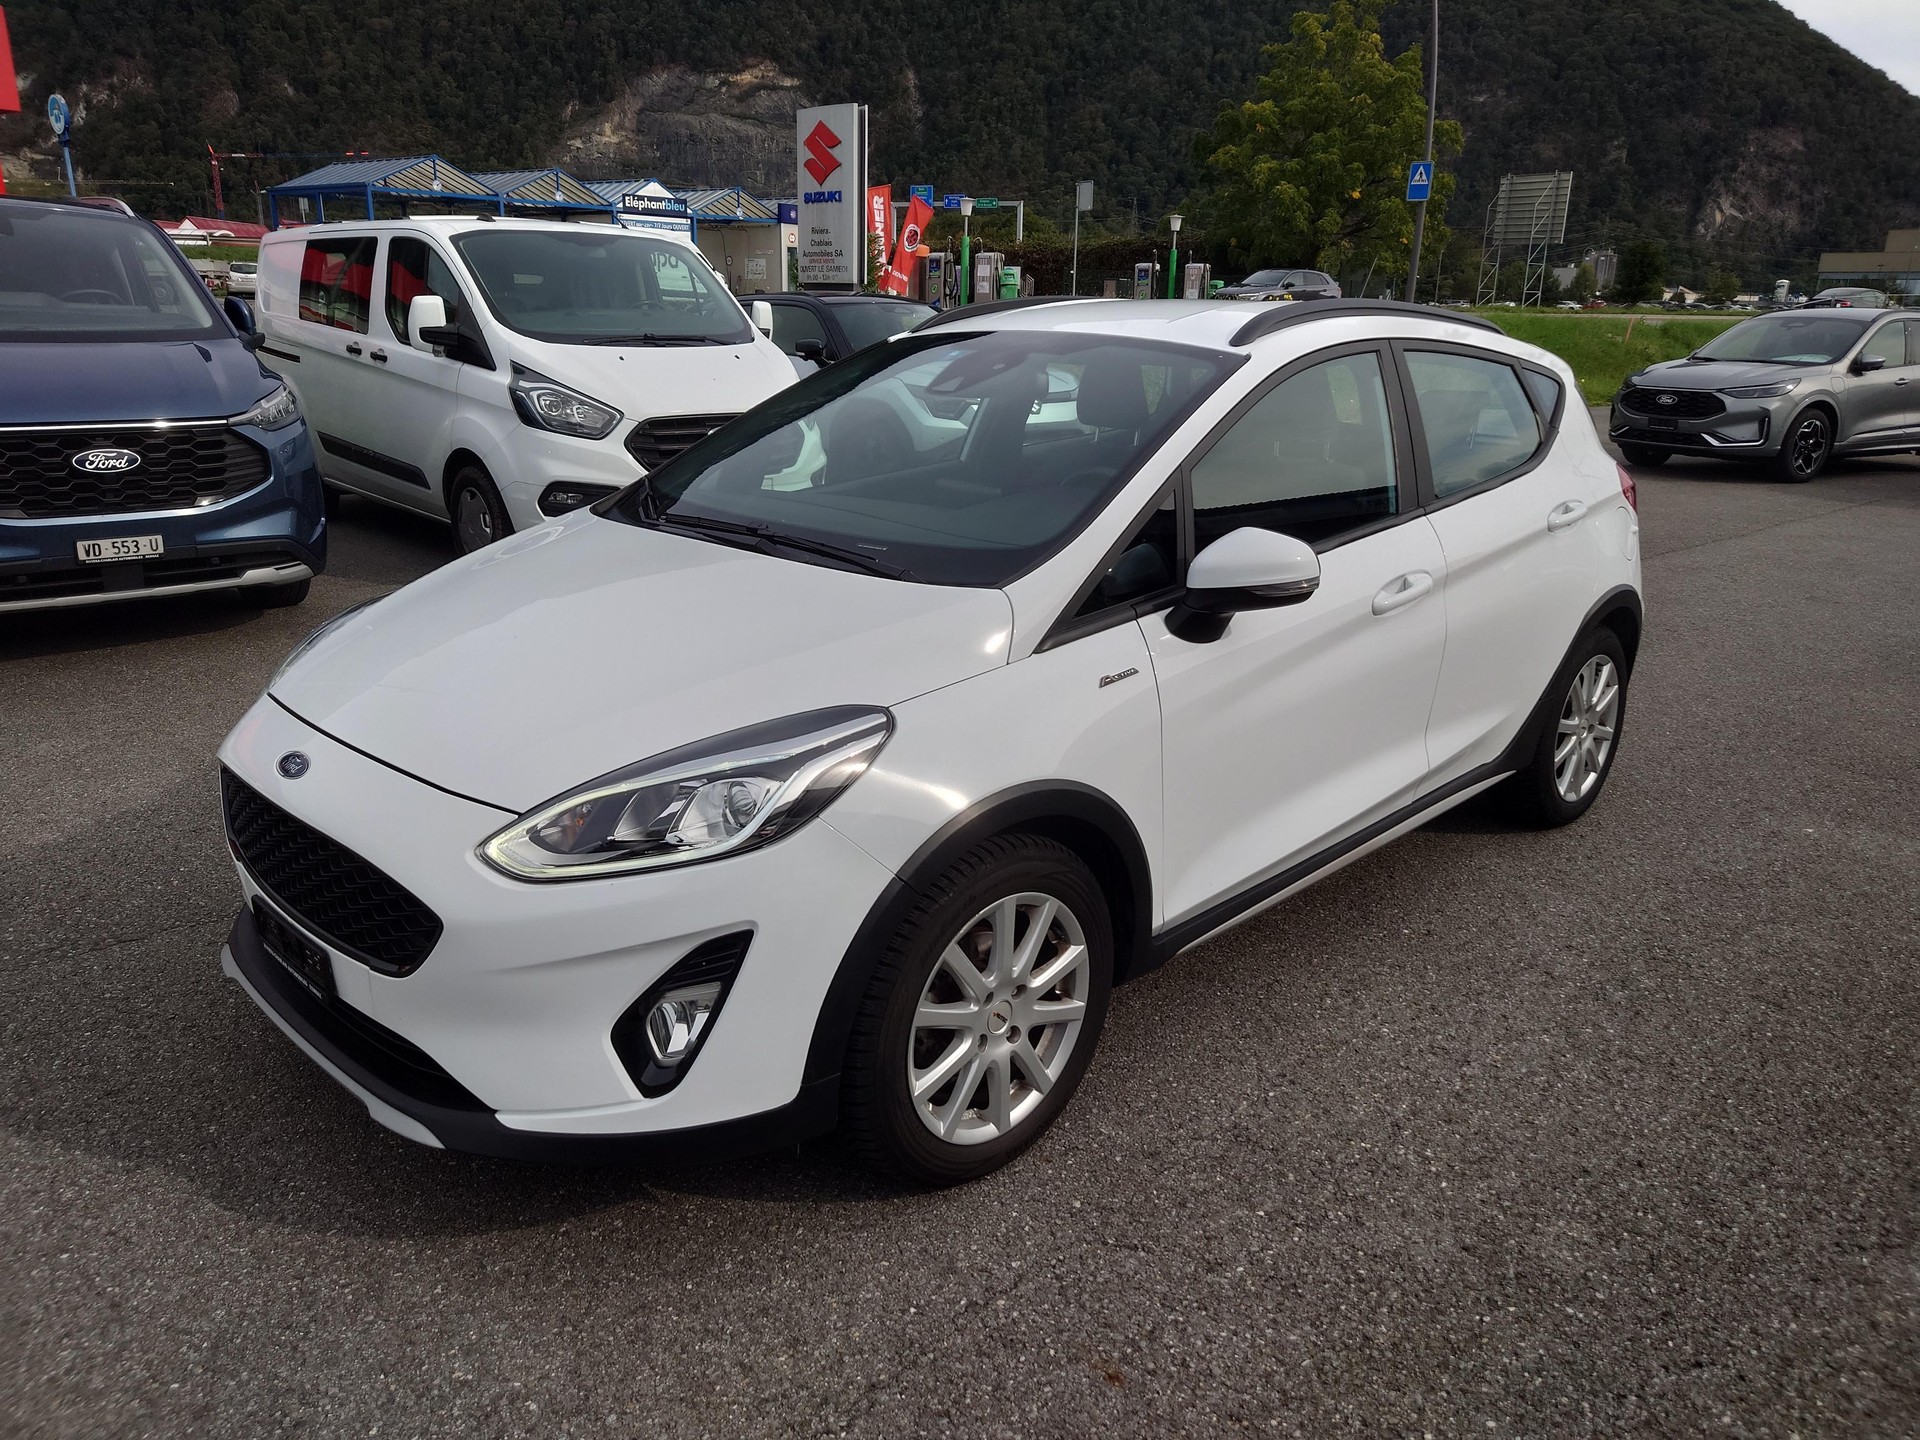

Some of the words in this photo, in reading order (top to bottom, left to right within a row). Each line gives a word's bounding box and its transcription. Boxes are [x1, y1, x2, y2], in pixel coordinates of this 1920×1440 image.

[803, 190, 842, 204] SUZUKI
[810, 238, 833, 247] Chablais
[802, 250, 834, 258] Automobiles
[834, 249, 844, 258] SA
[800, 265, 817, 273] OUVERT
[817, 265, 825, 273] LE
[85, 452, 129, 469] Ford
[82, 543, 102, 558] VD
[111, 539, 141, 555] 553
[148, 538, 159, 552] U
